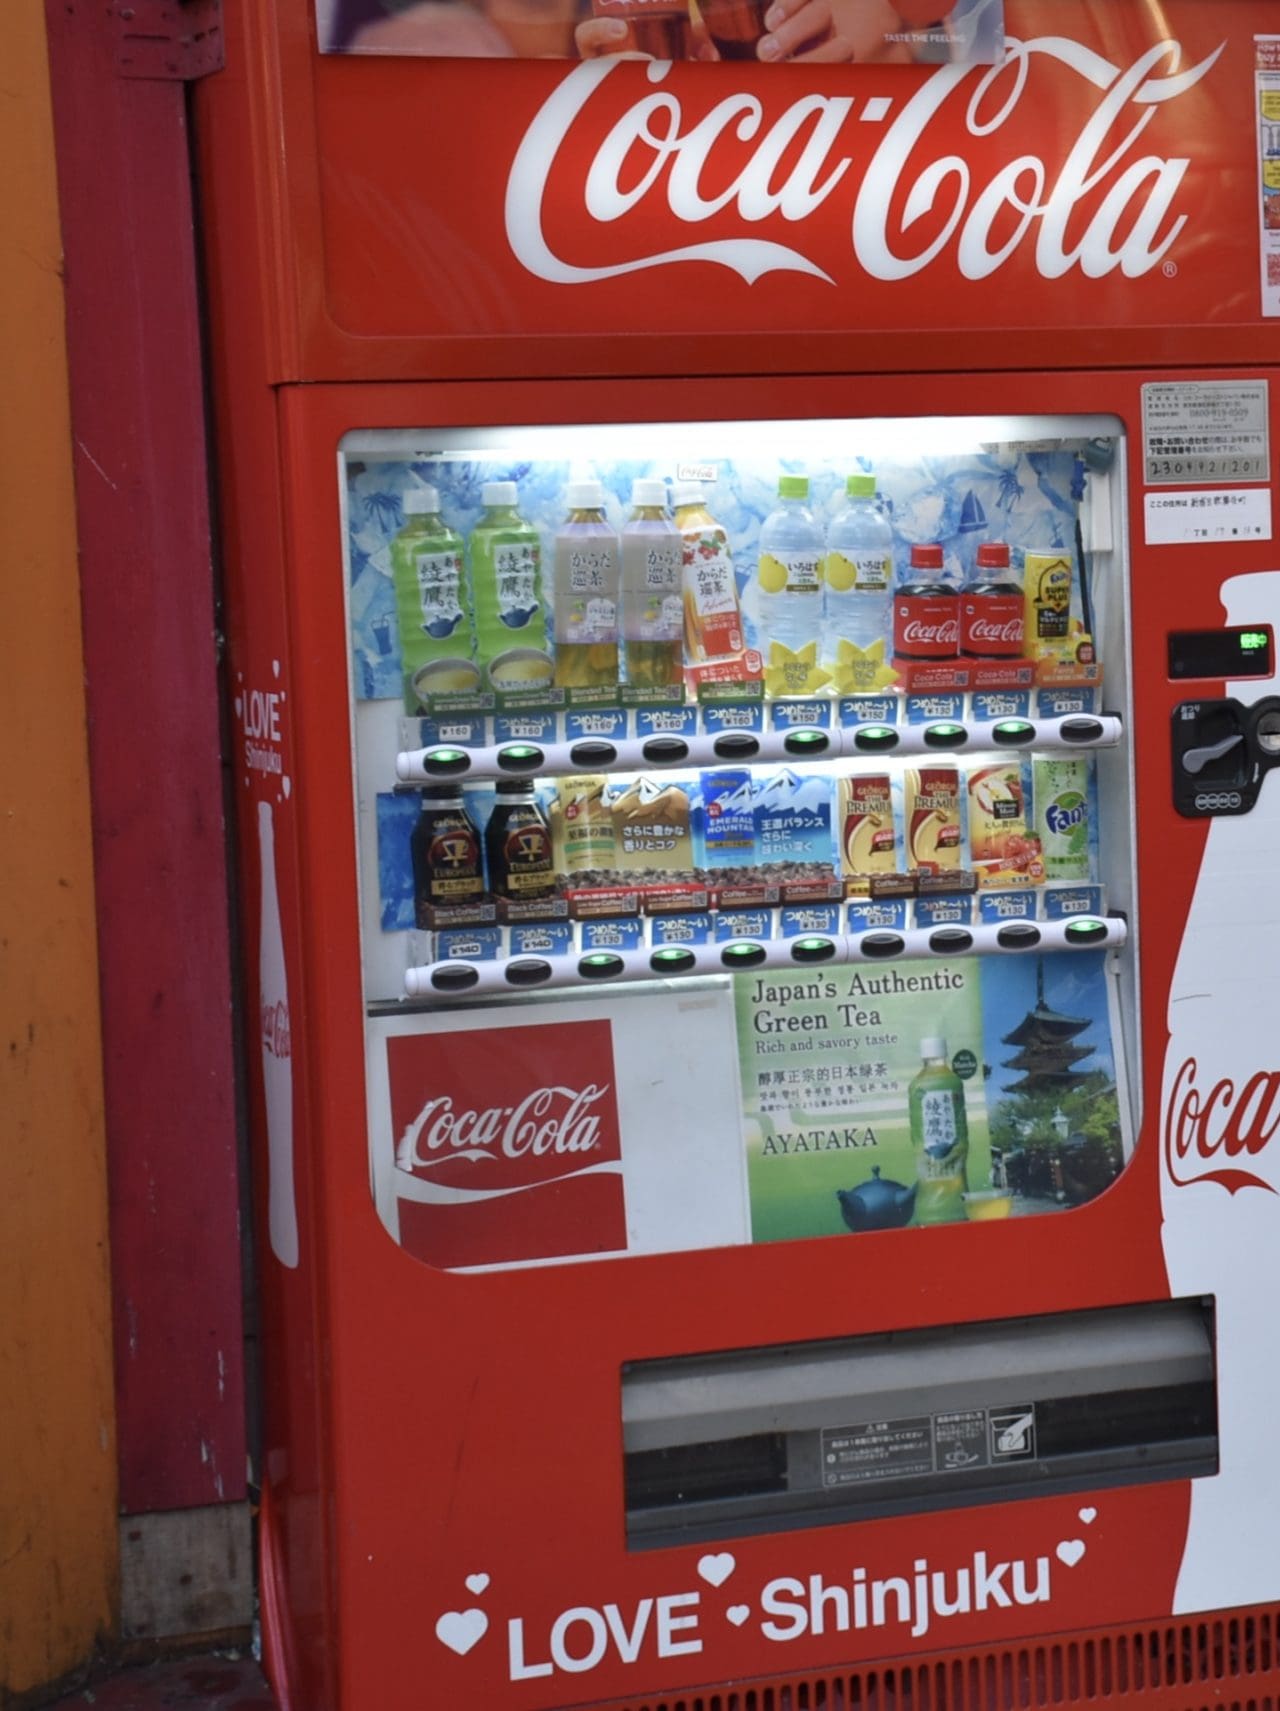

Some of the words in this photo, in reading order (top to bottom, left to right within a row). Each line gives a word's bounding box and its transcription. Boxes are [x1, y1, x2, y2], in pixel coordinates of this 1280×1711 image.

[912, 33, 928, 42] THE
[505, 37, 1228, 287] Coca-Cola
[243, 688, 282, 742] LOVE
[244, 740, 282, 778] Shinjuku
[623, 824, 685, 837] さらに豊かな
[761, 817, 825, 832] 王道バランス
[761, 830, 792, 843] さらに
[623, 839, 676, 853] 香りとコク
[751, 972, 837, 1007] Japan's
[847, 968, 965, 997] Authentic
[753, 1009, 829, 1034] Green
[837, 1003, 882, 1028] Tea
[755, 1039, 786, 1055] Rich
[790, 1037, 814, 1052] and
[817, 1034, 861, 1052] savory
[864, 1032, 899, 1046] taste
[757, 1062, 888, 1087] 醇厚正宗的日本绿茶
[402, 1083, 610, 1167] Coca-Cola
[761, 1127, 879, 1156] AYATAKA
[508, 1591, 703, 1681] LOVE
[758, 1551, 1051, 1642] Shinjuku
